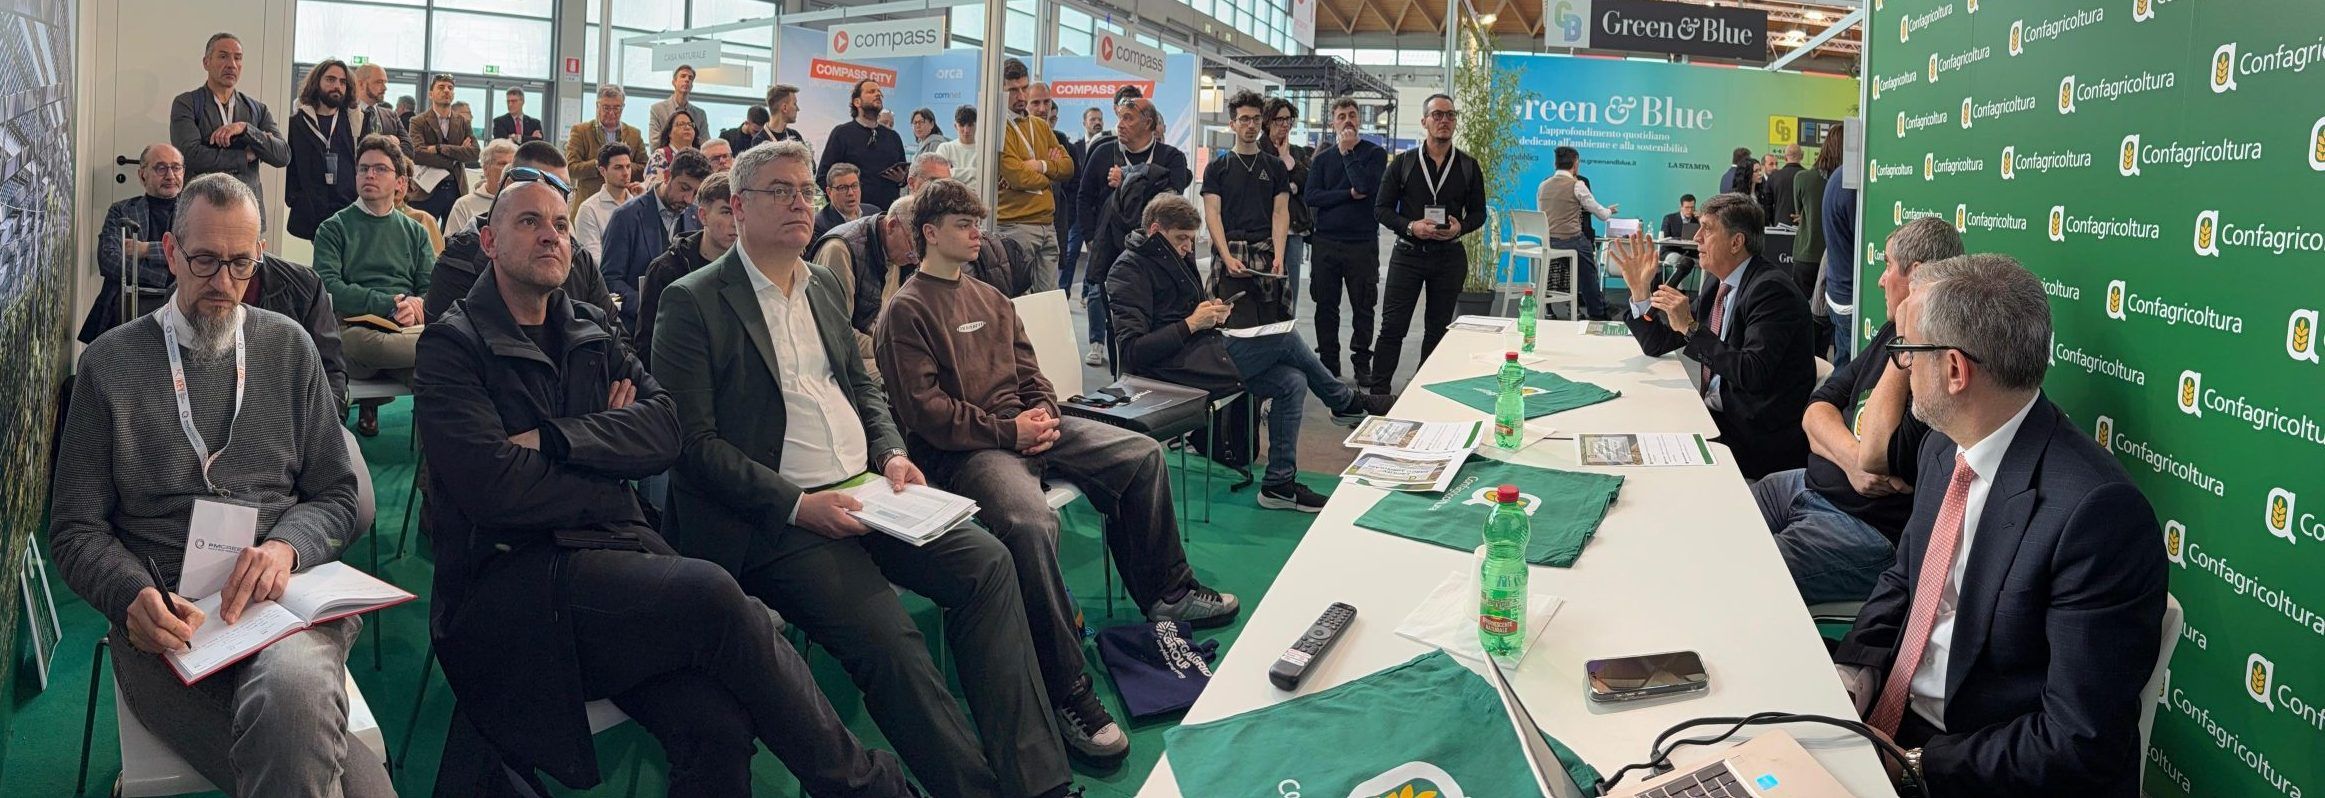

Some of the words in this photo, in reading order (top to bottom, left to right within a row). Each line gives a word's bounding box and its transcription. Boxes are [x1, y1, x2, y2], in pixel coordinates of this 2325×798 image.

[1602, 10, 1673, 39] Green
[1677, 17, 1700, 40] &
[1702, 18, 1753, 46] Blue
[1908, 4, 1952, 32] Confagricoltura
[2024, 8, 2104, 42] Confagricoltura
[854, 29, 937, 50] compass
[1116, 45, 1164, 72] compass
[1938, 47, 1990, 71] Confagricoltura
[816, 63, 868, 80] COMPASS
[935, 67, 964, 79] orca
[1880, 71, 1917, 91] Confagricoltura
[1056, 84, 1116, 95] COMPASS
[2077, 71, 2175, 101] Confagricoltura
[1604, 95, 1637, 125] &
[1642, 96, 1714, 130] Blue
[1973, 95, 2036, 119] Confagricoltura
[1905, 111, 1948, 130] Confagricoltura
[1519, 136, 1557, 147] dedicato
[1619, 141, 1636, 151] alla
[1637, 142, 1689, 153] sostenibilità
[1539, 125, 1621, 139] L'approfondimento
[1622, 130, 1670, 141] quotidiano
[2015, 151, 2091, 172] Confagricoltura
[2143, 138, 2262, 168] Confagricoltura
[1679, 162, 1711, 171] STAMPA
[1877, 163, 1913, 178] Confagricoltura
[1934, 156, 1983, 175] Confagricoltura
[1967, 211, 2027, 231] Confagricoltura
[2066, 216, 2159, 239] Confagricoltura
[2128, 294, 2243, 333] Confagricoltura
[2056, 343, 2145, 386] Confagricoltura
[2115, 433, 2224, 497] Confagricoltura
[2189, 544, 2325, 636] Confagricoltura
[1163, 633, 1191, 670] GROUP
